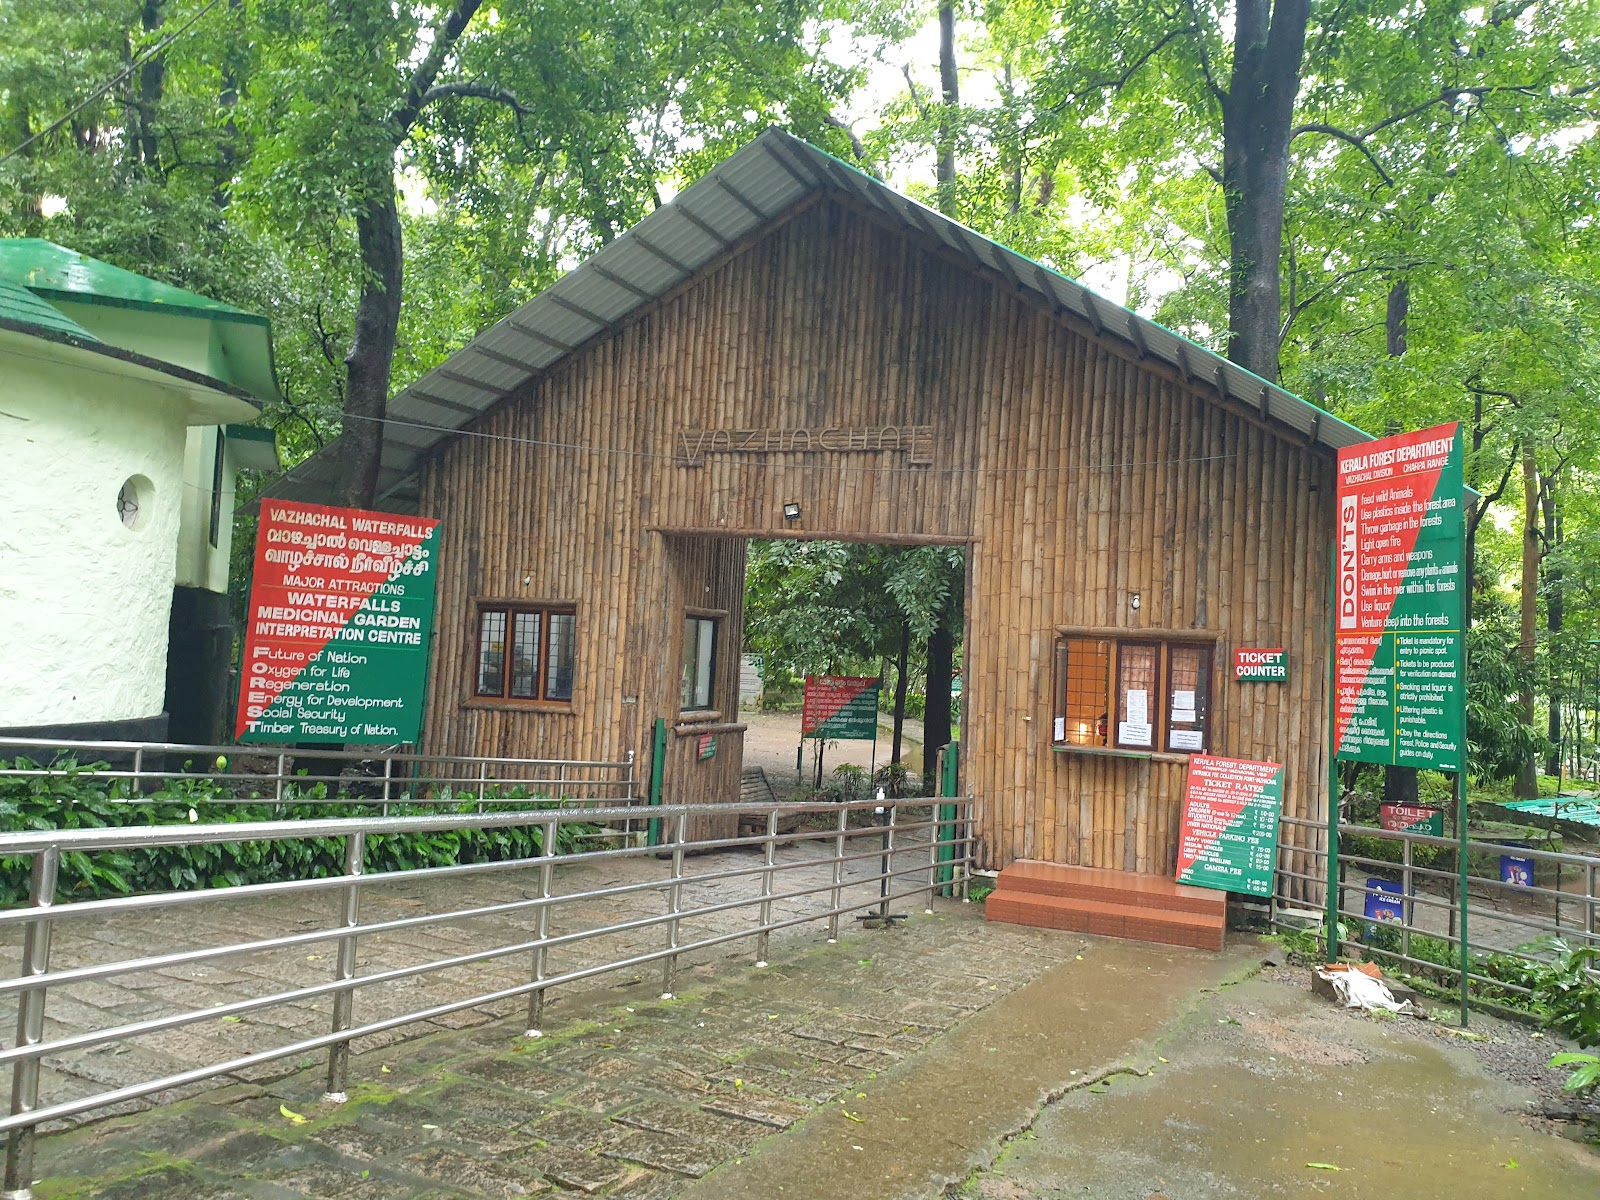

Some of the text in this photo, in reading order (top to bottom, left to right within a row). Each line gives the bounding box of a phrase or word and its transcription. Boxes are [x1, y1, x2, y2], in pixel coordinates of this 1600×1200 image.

[681, 426, 933, 466] VAZHACHAL
[1340, 436, 1455, 474] KERALA FOREST DEPARTMENT
[1427, 455, 1449, 469] RANGE
[1361, 508, 1371, 520] Use
[1393, 501, 1411, 515] inside
[1412, 499, 1423, 512] the
[1424, 496, 1442, 511] forest
[1442, 497, 1455, 508] area
[270, 508, 434, 540] VAZHACHAL WATERFALLS
[1361, 523, 1378, 535] Throw
[1380, 520, 1402, 536] garbage
[1409, 516, 1419, 528] the
[1420, 513, 1442, 527] forests
[1361, 536, 1401, 552] Light open fire
[1361, 553, 1377, 566] Carry
[1393, 549, 1405, 562] and
[1405, 549, 1433, 563] weapons
[283, 574, 405, 596] MAJOR ATTRACTIONS
[1361, 583, 1376, 597] Swim
[1377, 583, 1383, 596] in
[1383, 582, 1393, 595] the
[1393, 582, 1405, 594] river
[1425, 579, 1435, 593] the
[1436, 578, 1455, 592] forests
[287, 592, 401, 613] WATERFALLS
[1361, 599, 1391, 614] Use liquor
[257, 606, 420, 629] MEDICINAL GARDEN
[1400, 613, 1412, 627] into
[1412, 613, 1424, 626] the
[1425, 612, 1449, 626] forests
[256, 622, 422, 645] INTERPRETATION CENTRE
[252, 646, 367, 665] Future of Nation
[1238, 652, 1282, 663] TICKET
[251, 662, 350, 678] Oxygen for Life
[1236, 665, 1285, 676] COUNTER
[249, 677, 350, 692] Regeneration
[248, 691, 404, 710] Energy for Development
[246, 705, 346, 722] Social Security
[245, 720, 399, 737] Timber Treasury of Nation.
[1193, 757, 1214, 766] KERALA
[1216, 760, 1238, 769] FOREST
[1238, 762, 1278, 774] DEPARTMENT
[1204, 779, 1233, 789] TICKET
[1235, 782, 1264, 793] RATES
[1189, 801, 1210, 809] ADULTS
[1388, 805, 1436, 818] TOILET
[1204, 863, 1228, 873] CAMERA
